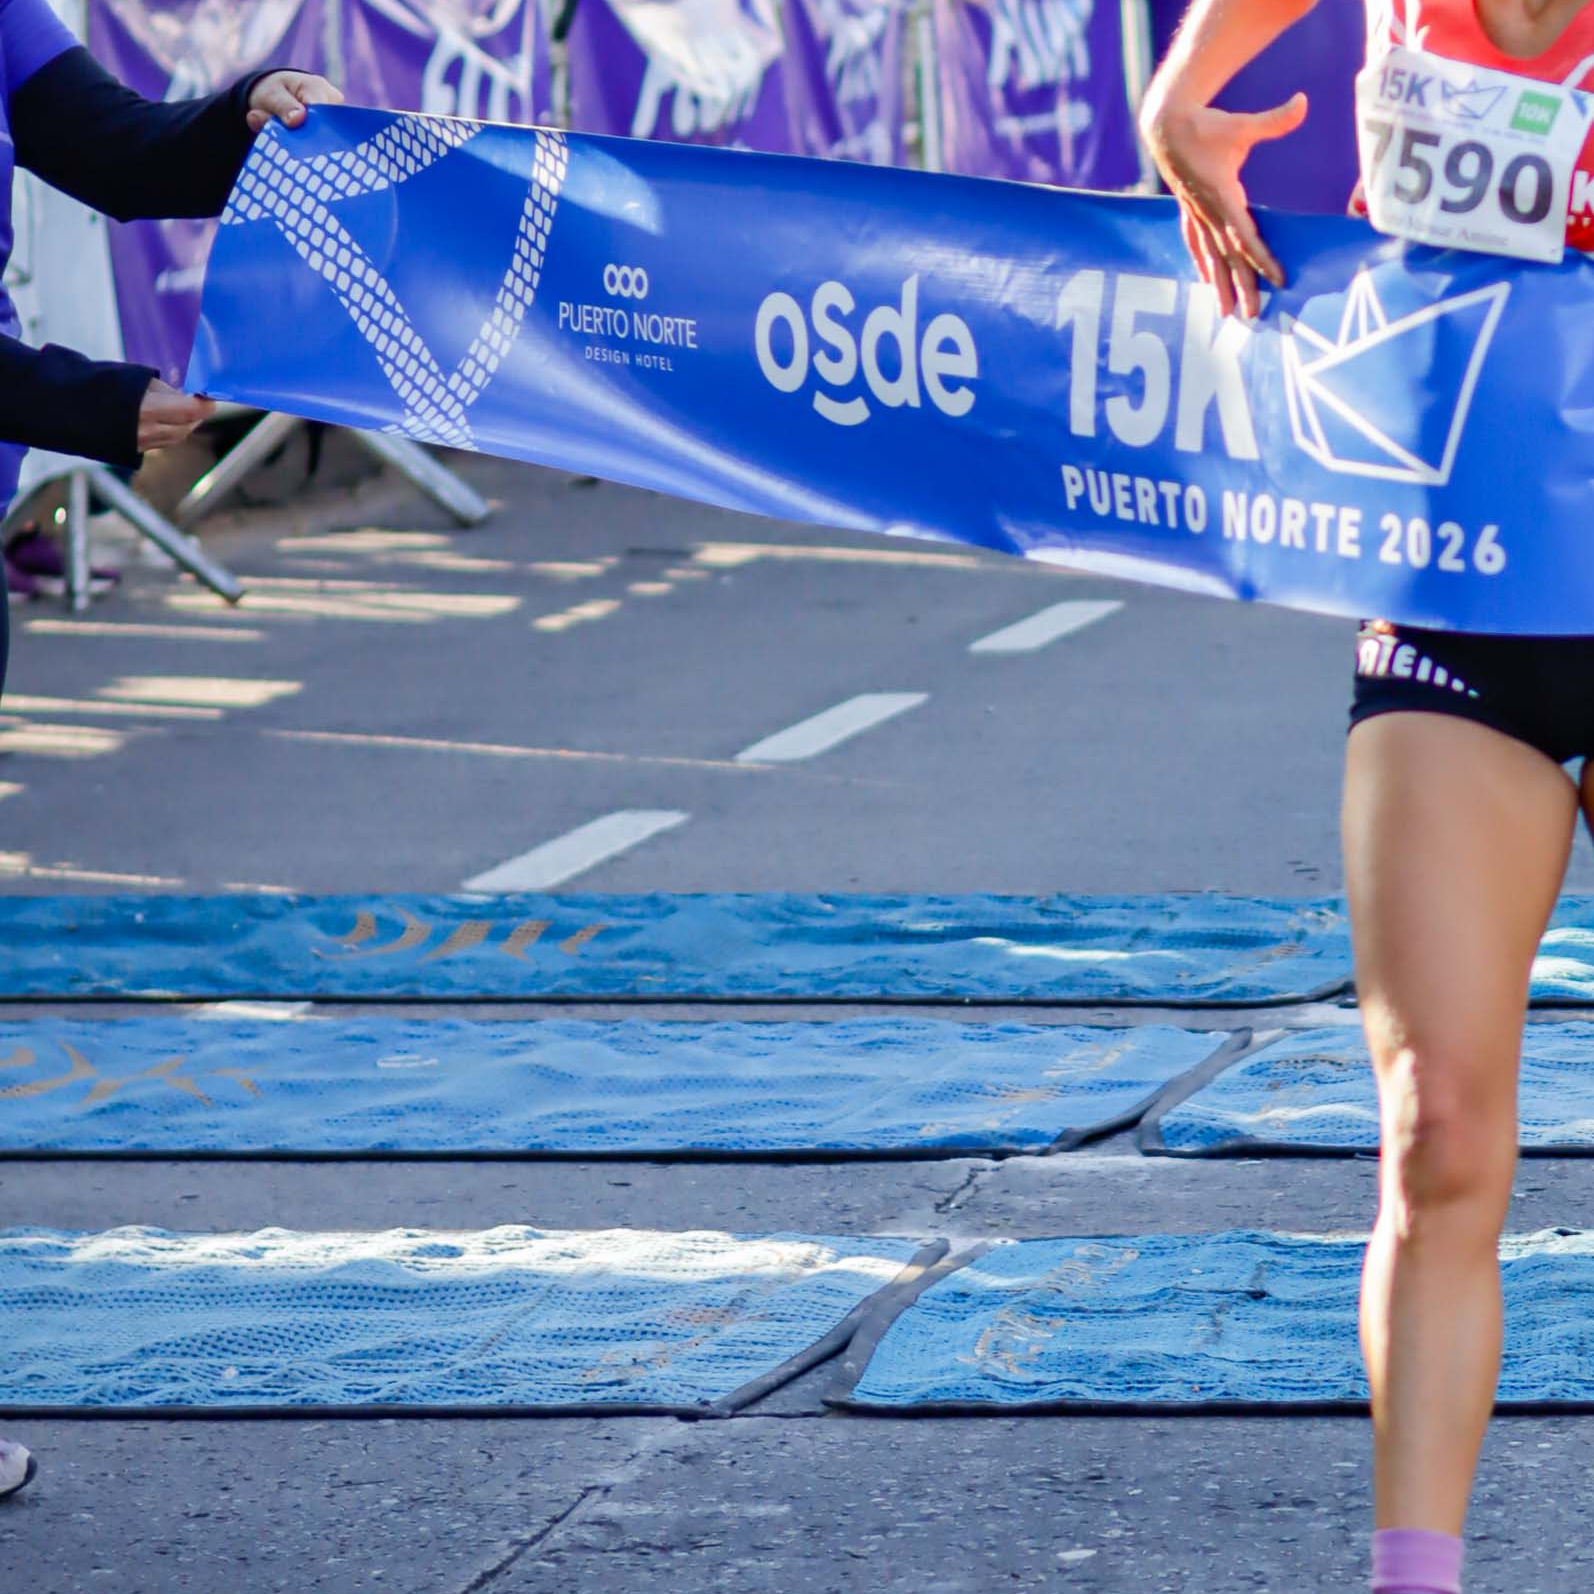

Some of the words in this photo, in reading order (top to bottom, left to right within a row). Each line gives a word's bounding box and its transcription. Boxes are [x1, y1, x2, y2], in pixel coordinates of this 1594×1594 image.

[1379, 68, 1434, 108] 15K
[1365, 118, 1554, 225] 7590
[558, 300, 630, 339] PUERTO
[633, 311, 699, 350] NORTE
[585, 345, 630, 365] DESIGN
[635, 353, 675, 372] HOTEL
[755, 273, 979, 418] osde
[1056, 269, 1272, 461] 15K
[1061, 464, 1208, 534] PUERTO
[1221, 489, 1363, 559] NORTE
[1378, 512, 1507, 576] 2026
